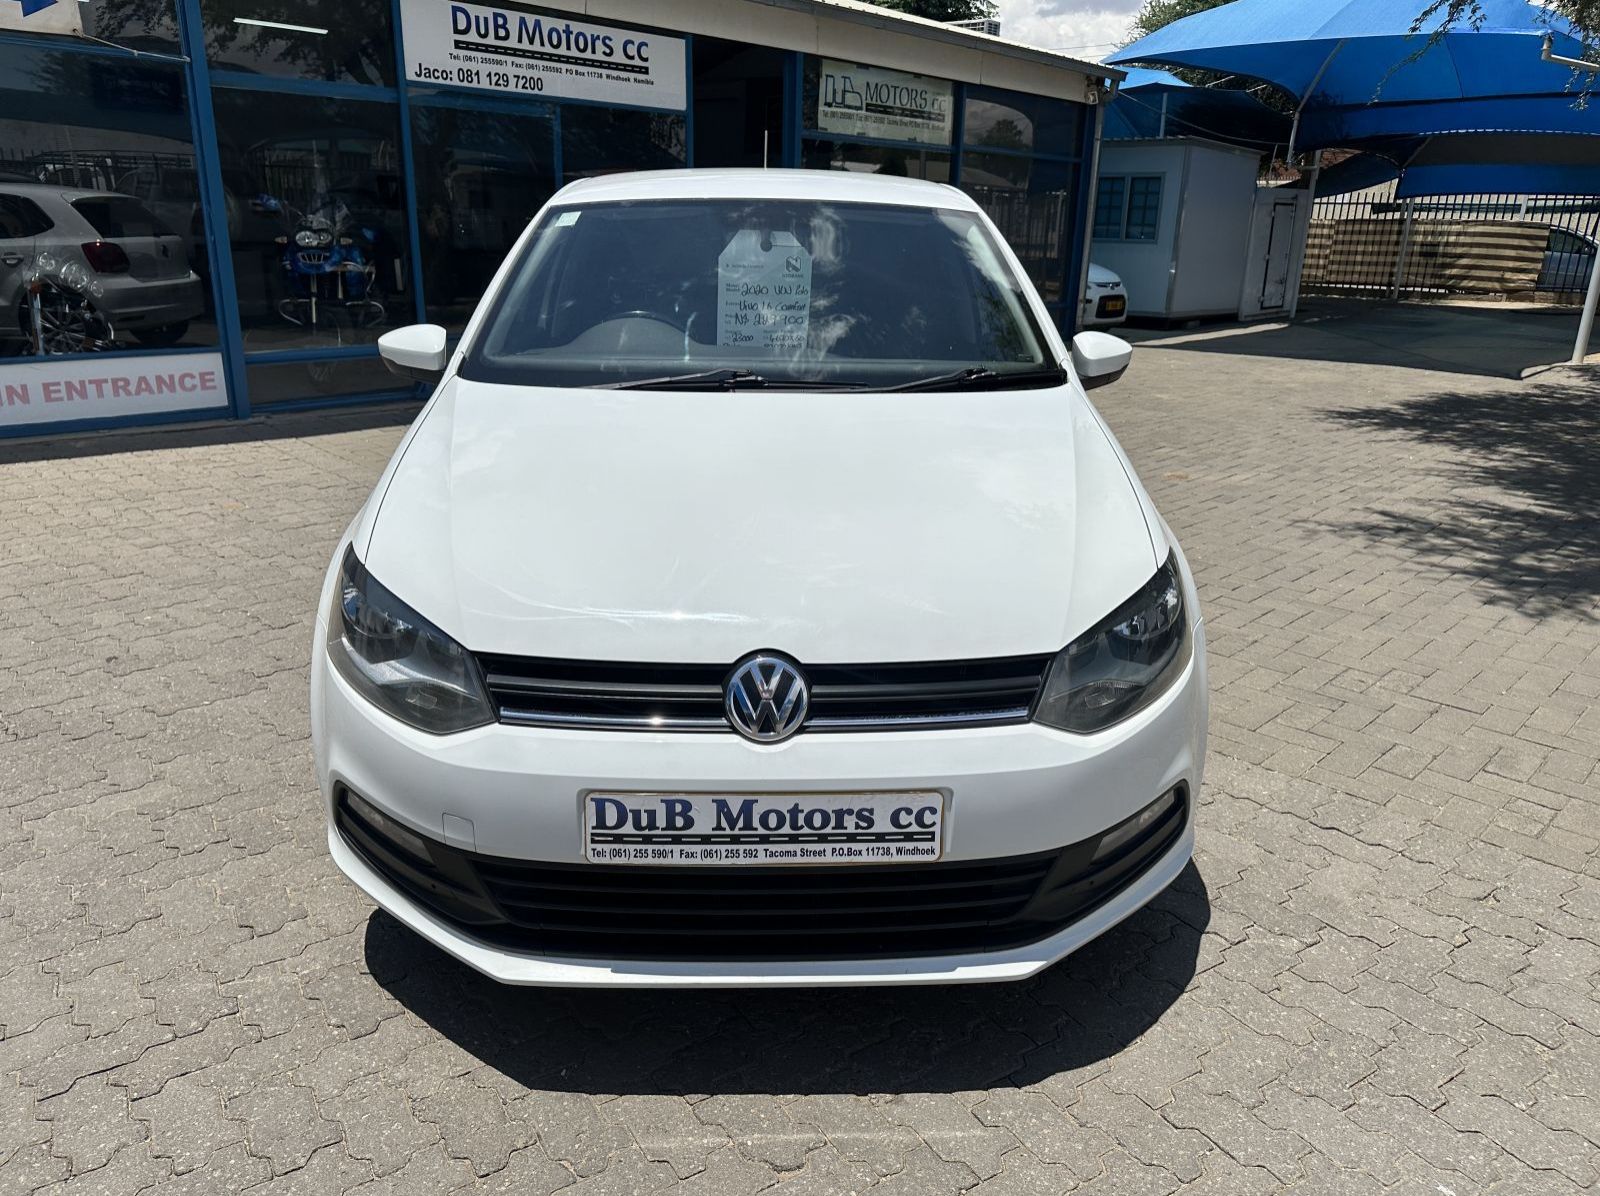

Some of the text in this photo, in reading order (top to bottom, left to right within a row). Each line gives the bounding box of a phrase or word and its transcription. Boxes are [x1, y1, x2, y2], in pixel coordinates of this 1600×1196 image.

[451, 5, 510, 41] DuB
[517, 16, 614, 57] Motors
[415, 63, 543, 91] Jaco: 081 129 7200
[448, 53, 461, 61] Tel:
[462, 55, 479, 64] (061)
[480, 57, 508, 67] 255590/1
[525, 63, 540, 72] (061)
[541, 65, 563, 74] 255592
[587, 71, 603, 79] 11738
[606, 74, 631, 83] Windhoek
[634, 78, 654, 86] Namibia
[865, 81, 928, 110] MOTORS
[741, 283, 769, 297] 2020
[41, 371, 217, 403] ENTRANCE
[591, 798, 695, 832] DuB
[712, 799, 875, 832] Motors
[591, 845, 936, 860] Tel: (061) 255 590/1 Fax: (061) 255 592 Tacoma Street P.O.Box 11738, Windhoek
